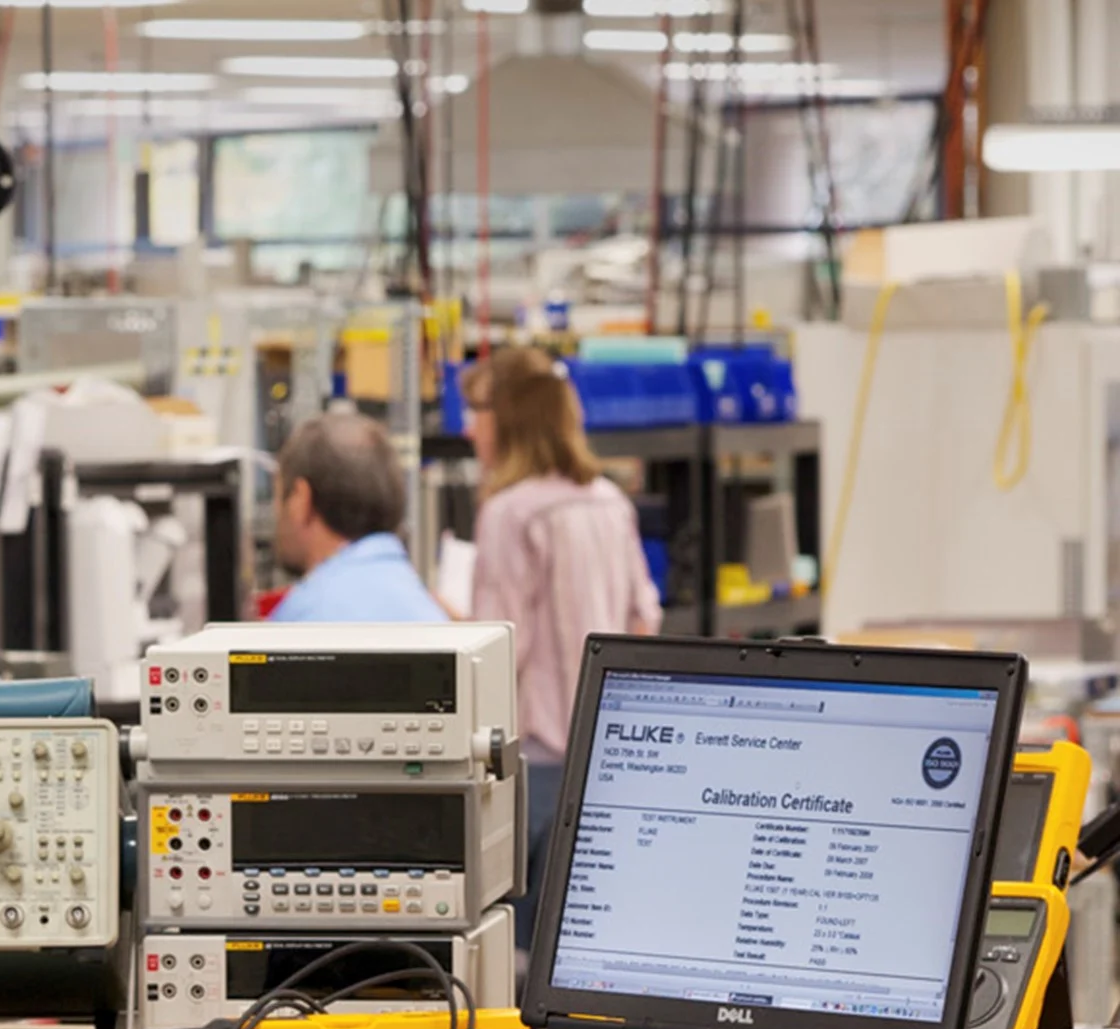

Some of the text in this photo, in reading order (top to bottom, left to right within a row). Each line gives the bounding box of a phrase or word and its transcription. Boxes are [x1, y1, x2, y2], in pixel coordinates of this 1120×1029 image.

[604, 723, 674, 743] FLUKE
[695, 732, 802, 750] Everett Service Center
[701, 787, 853, 814] Calibration Certificate
[717, 1006, 754, 1024] DELL
